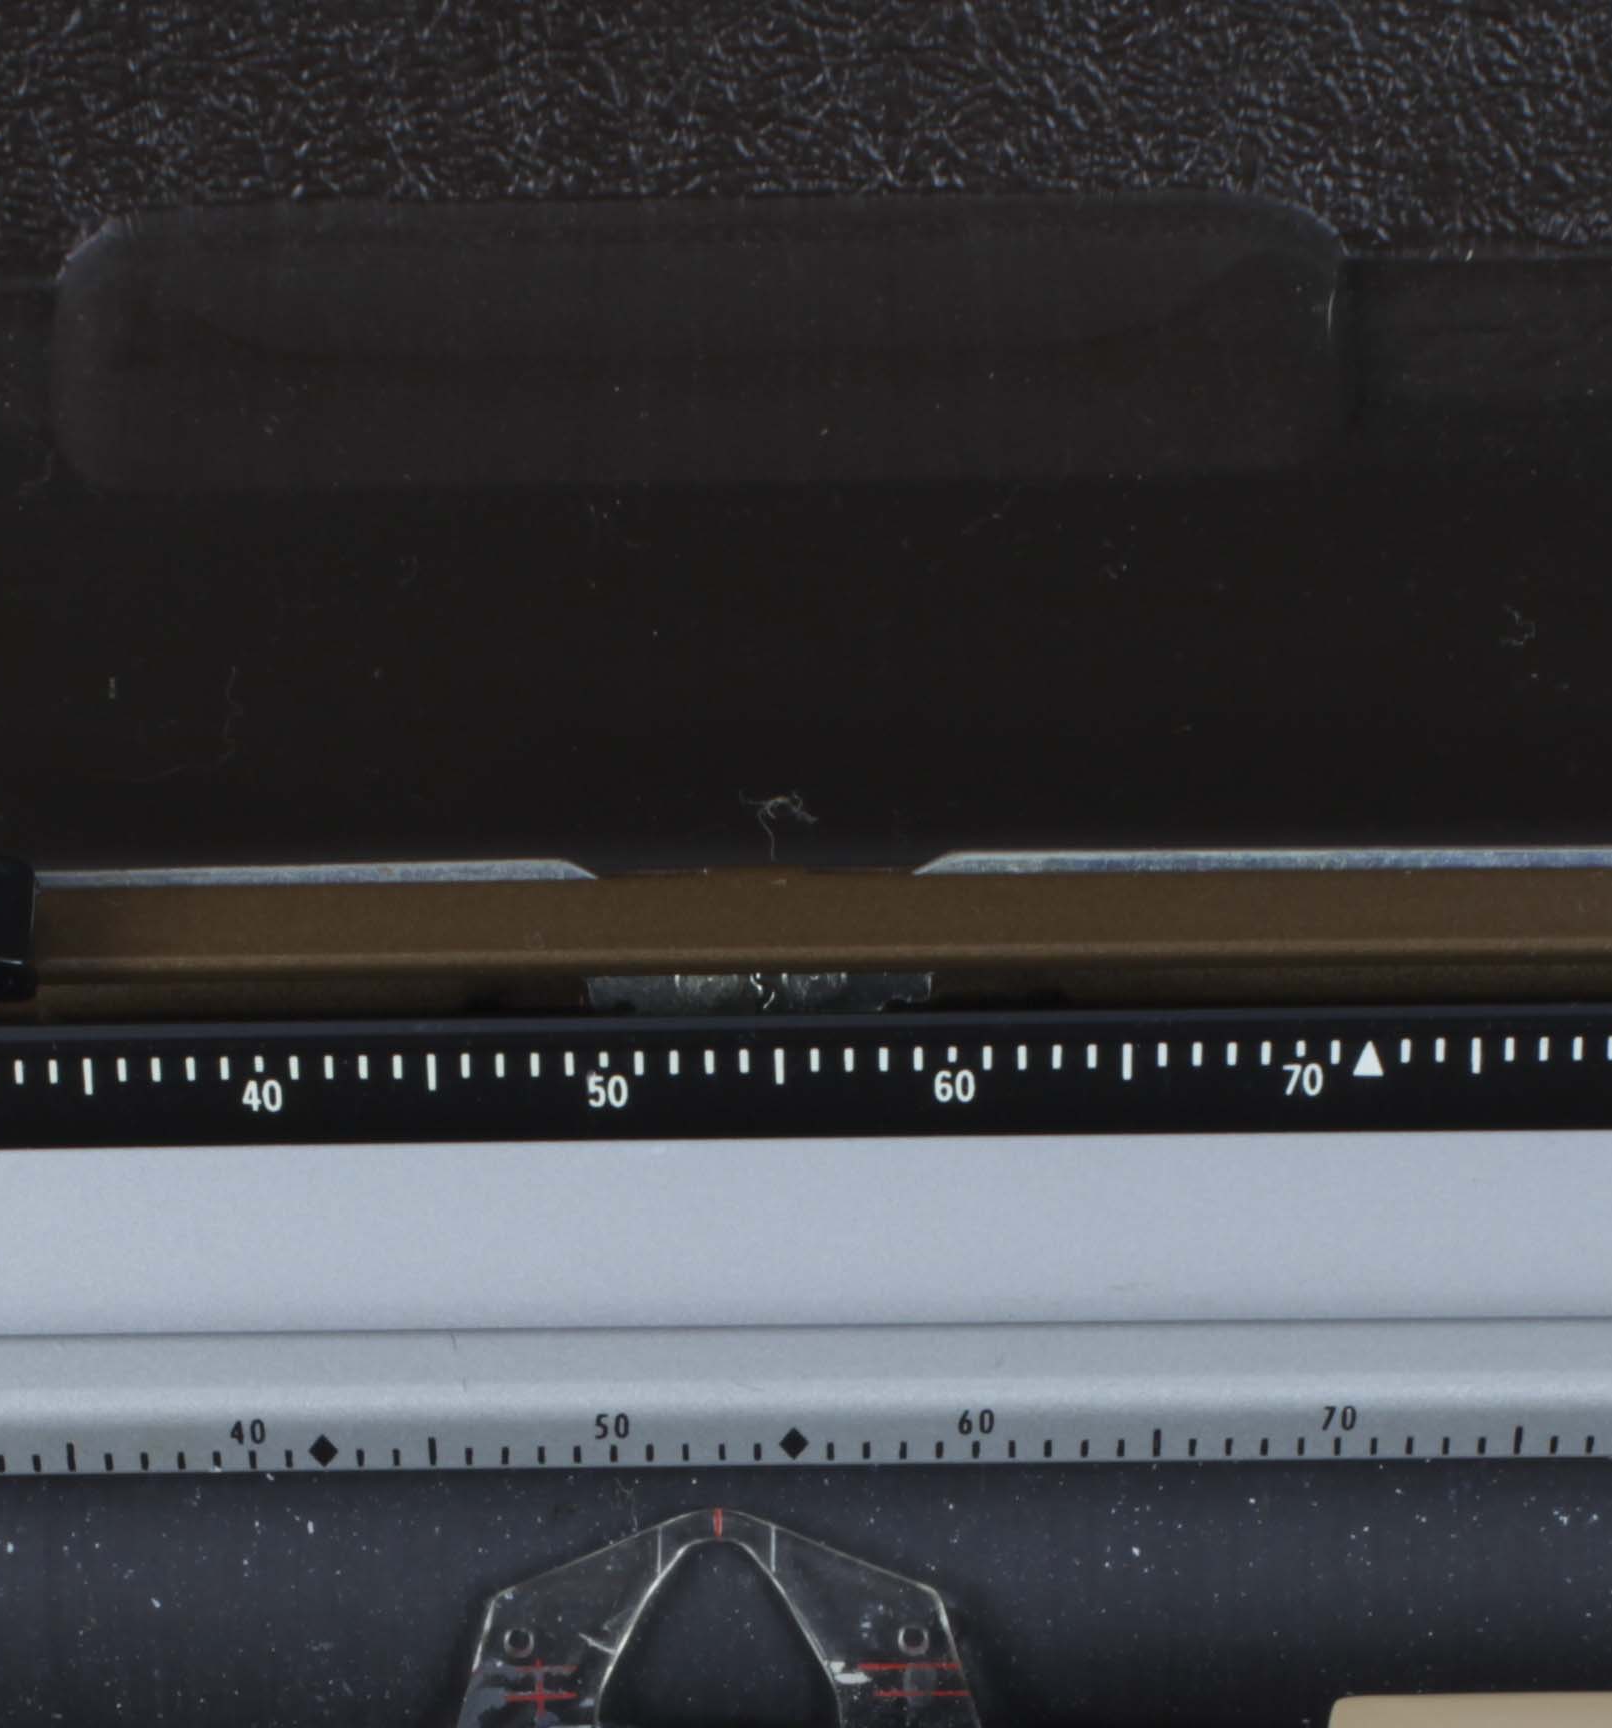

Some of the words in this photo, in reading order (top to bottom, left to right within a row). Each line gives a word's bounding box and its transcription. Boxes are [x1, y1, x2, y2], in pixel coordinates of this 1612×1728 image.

[242, 1079, 283, 1113] 40
[586, 1073, 629, 1108] 50
[934, 1069, 976, 1103] 60
[1282, 1062, 1324, 1097] 70
[229, 1418, 267, 1446] 40
[594, 1412, 630, 1441] 50
[957, 1409, 995, 1436] 60
[1321, 1405, 1358, 1432] 70
